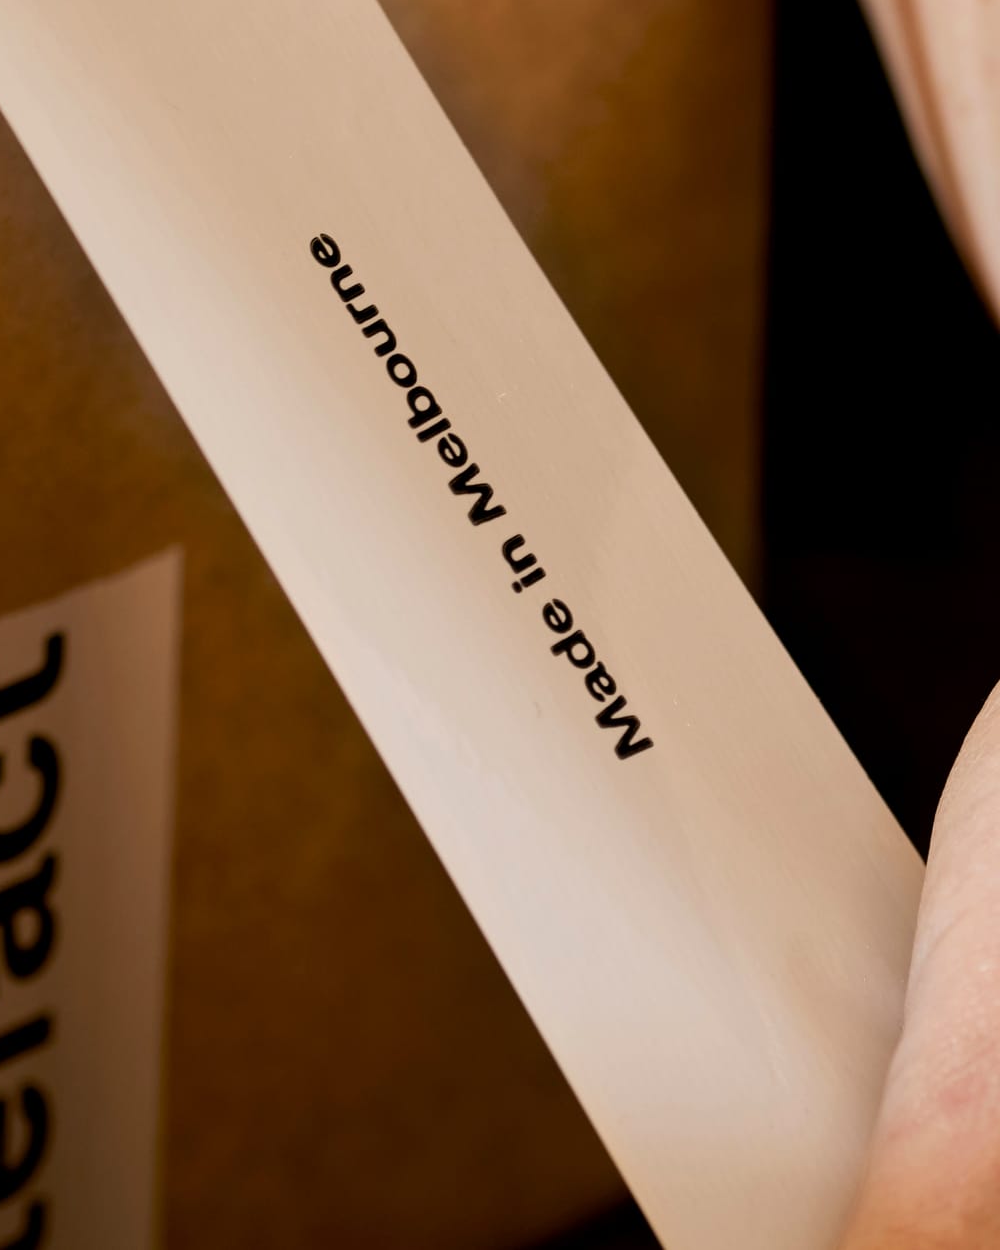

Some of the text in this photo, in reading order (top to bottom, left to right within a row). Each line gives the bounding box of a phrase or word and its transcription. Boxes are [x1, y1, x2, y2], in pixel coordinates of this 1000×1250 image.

[309, 232, 654, 761] Made in Melbourne
